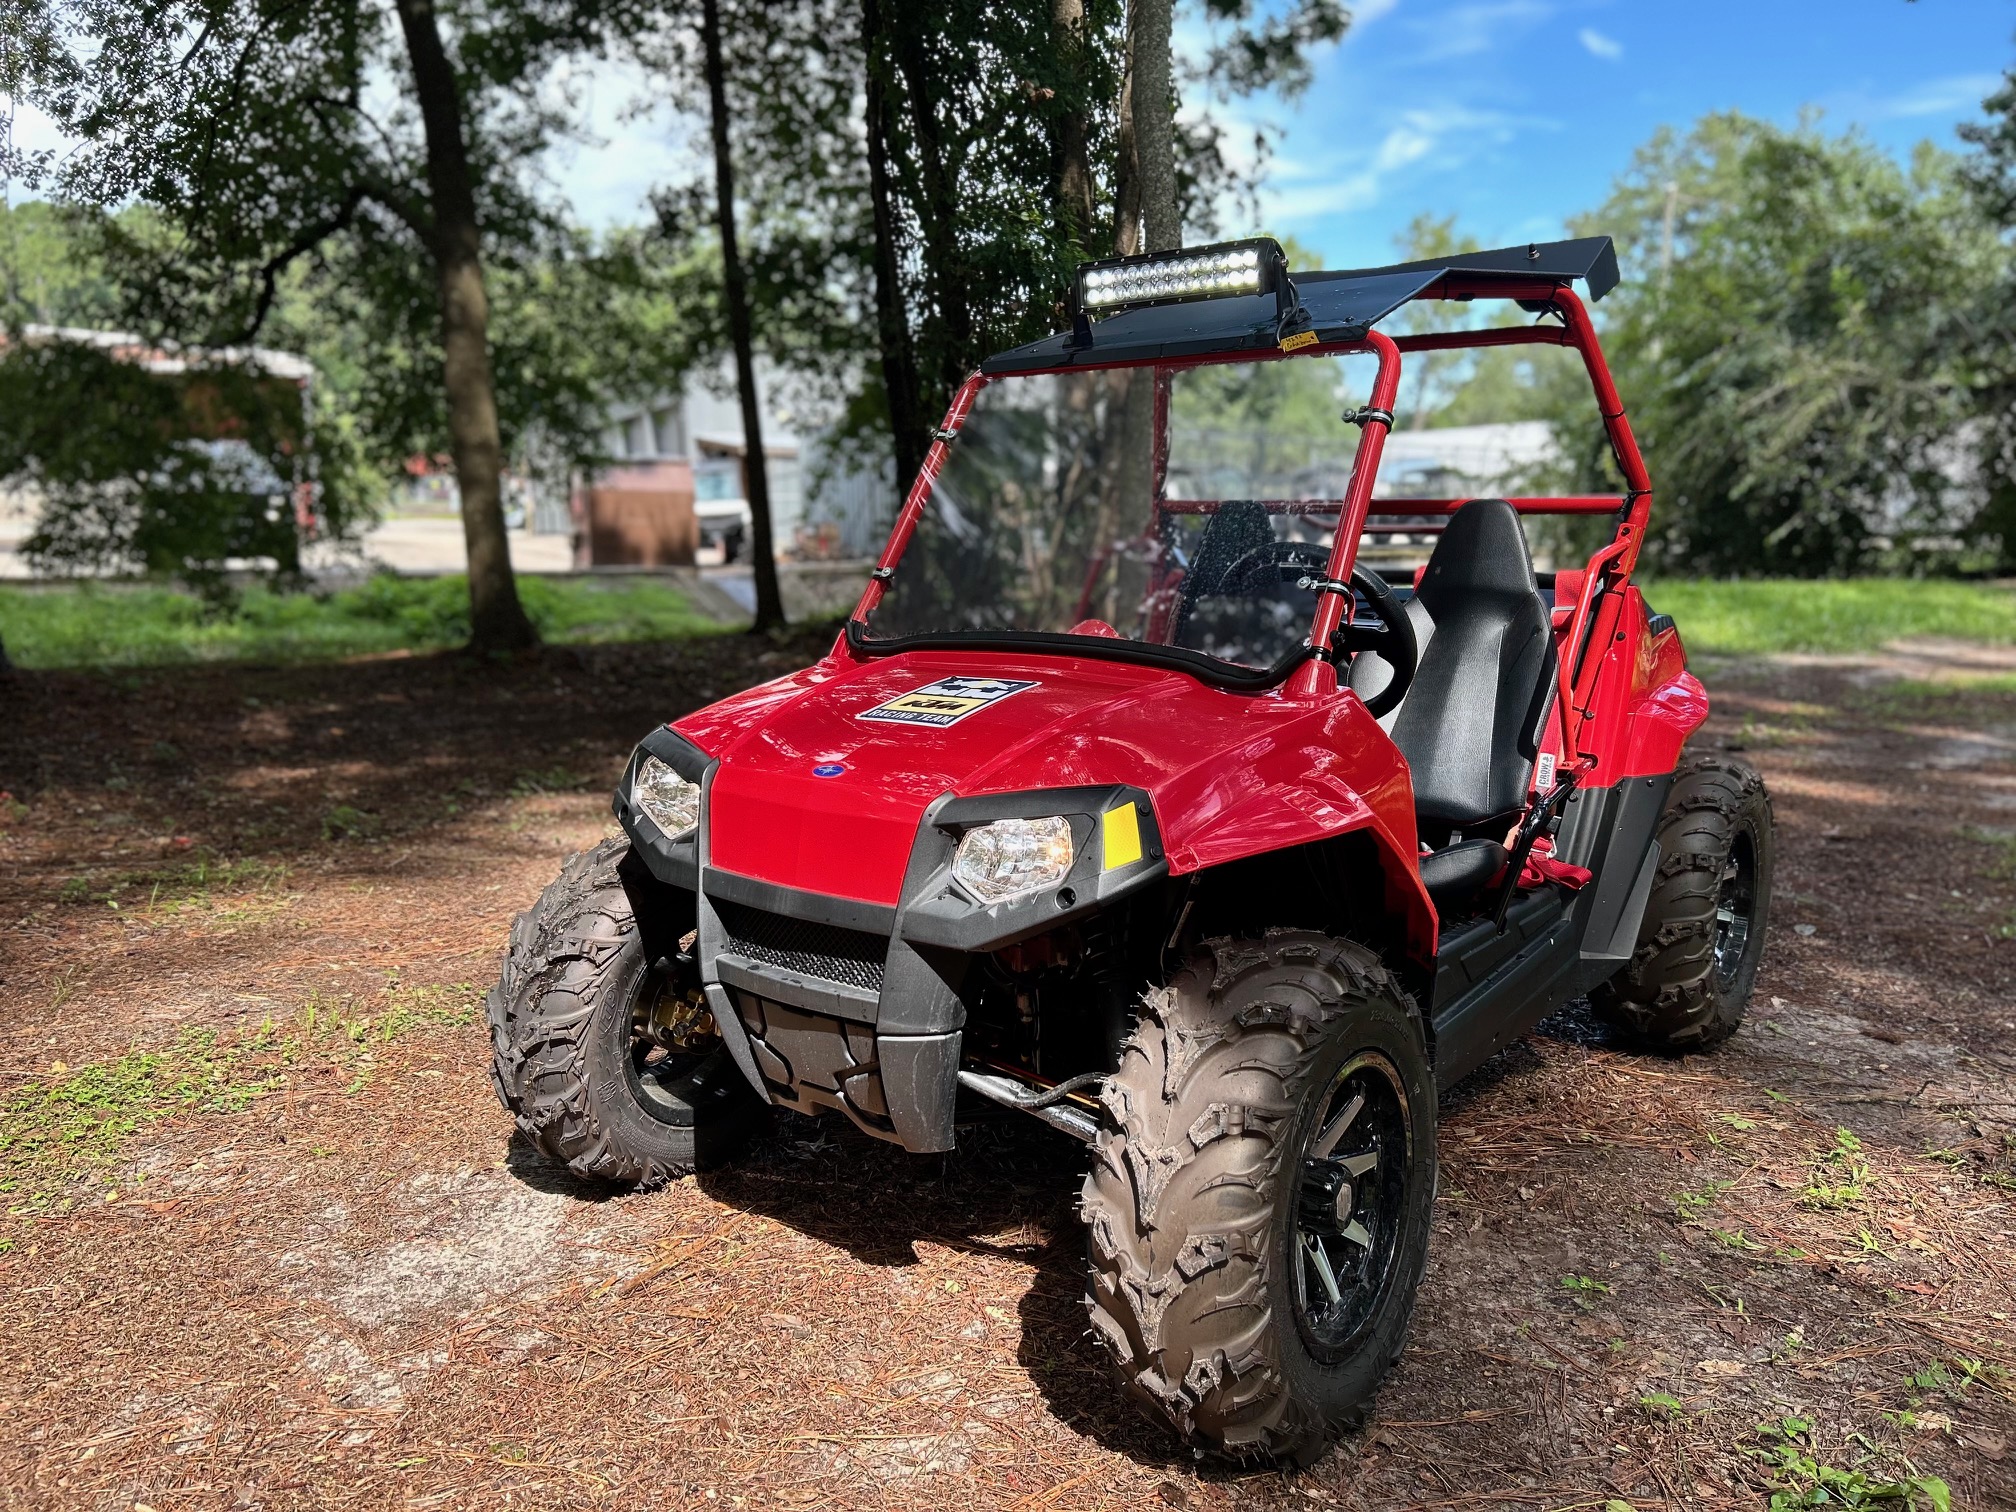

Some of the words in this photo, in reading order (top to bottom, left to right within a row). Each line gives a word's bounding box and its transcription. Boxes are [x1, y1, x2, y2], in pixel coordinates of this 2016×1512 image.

[899, 699, 967, 711] KTM
[867, 709, 917, 721] RACING
[920, 713, 955, 724] TEAM
[1538, 761, 1549, 785] CROW
